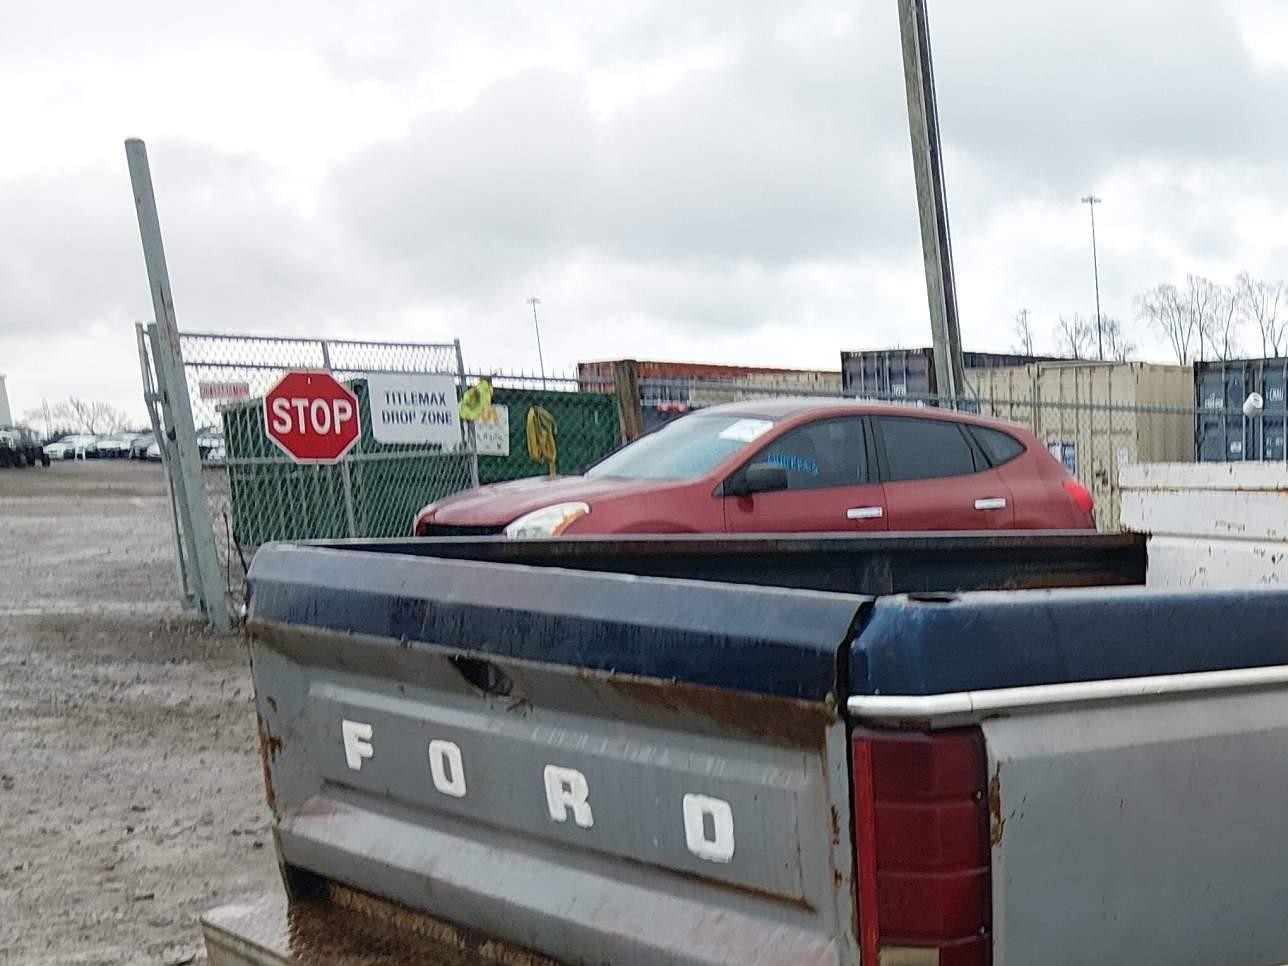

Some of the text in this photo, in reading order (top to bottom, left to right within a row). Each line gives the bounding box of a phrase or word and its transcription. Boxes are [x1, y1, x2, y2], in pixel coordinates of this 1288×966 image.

[384, 391, 447, 406] TITLEMAX
[272, 397, 353, 435] STOP
[381, 411, 452, 426] DROP ZONE
